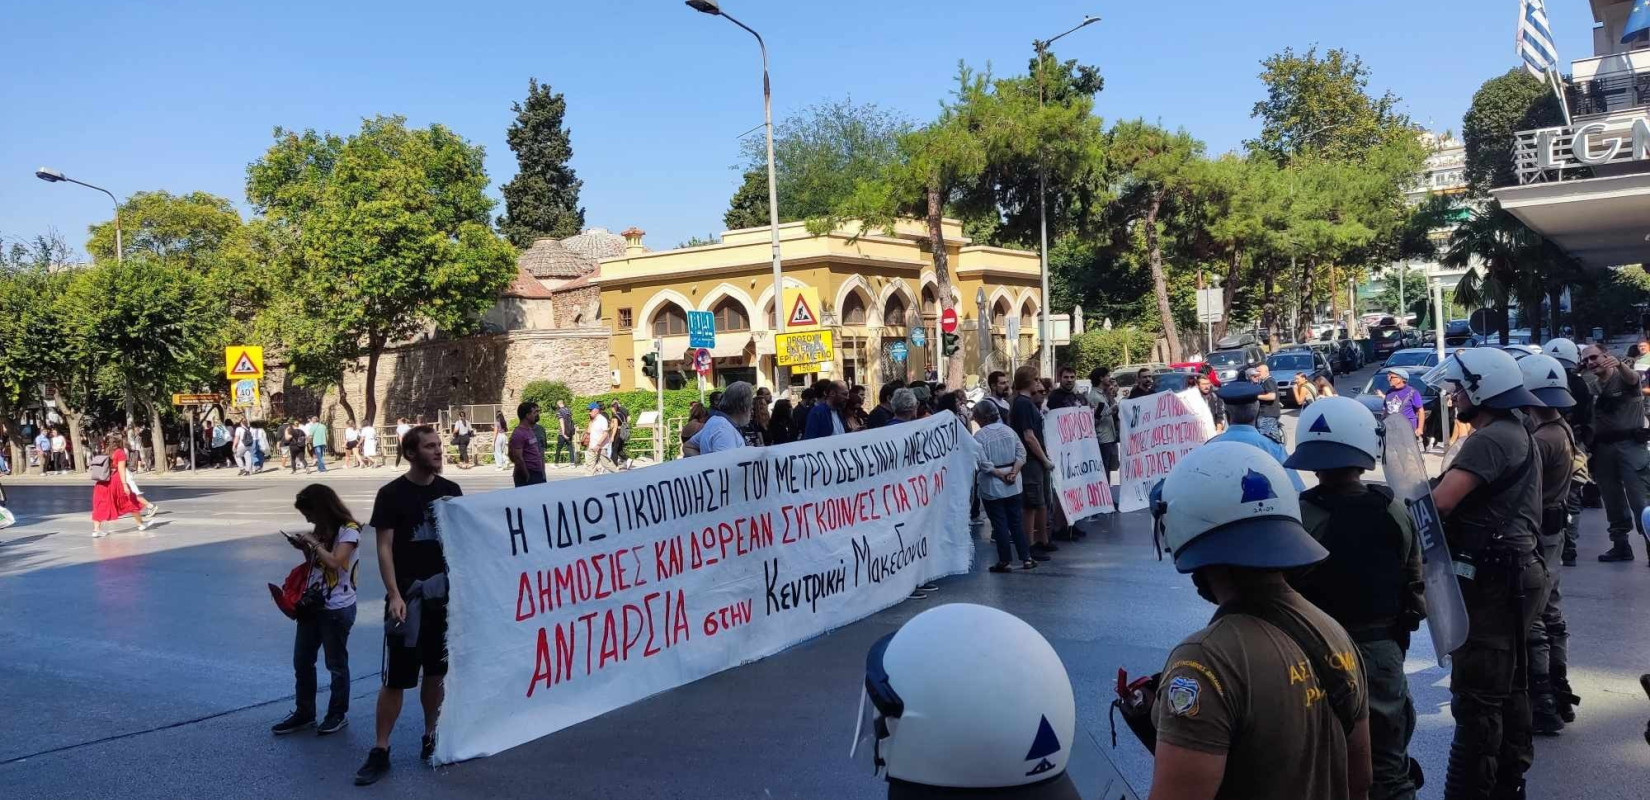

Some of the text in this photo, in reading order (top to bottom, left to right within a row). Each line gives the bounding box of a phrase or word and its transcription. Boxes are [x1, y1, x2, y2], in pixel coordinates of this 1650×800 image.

[505, 418, 960, 556] Η ΙΔΙΩΤΙΚΟΠΟΙΗΣΗ ΤΟΥ ΜΕΤΡΟ ΔΕΝ ΕΙΝΑΙ ΑΝΕΚΔΟΤΟ!
[515, 545, 647, 622] ΔΗΜΟΣΙΕΣ
[654, 535, 684, 582] ΚΑΙ
[690, 512, 774, 570] ΔΩΡΕΑΝ
[882, 483, 912, 517] ΓΙΑ
[907, 474, 929, 507] ΤΟ
[526, 588, 690, 698] ΑΝΤΑΡΣΙΑ
